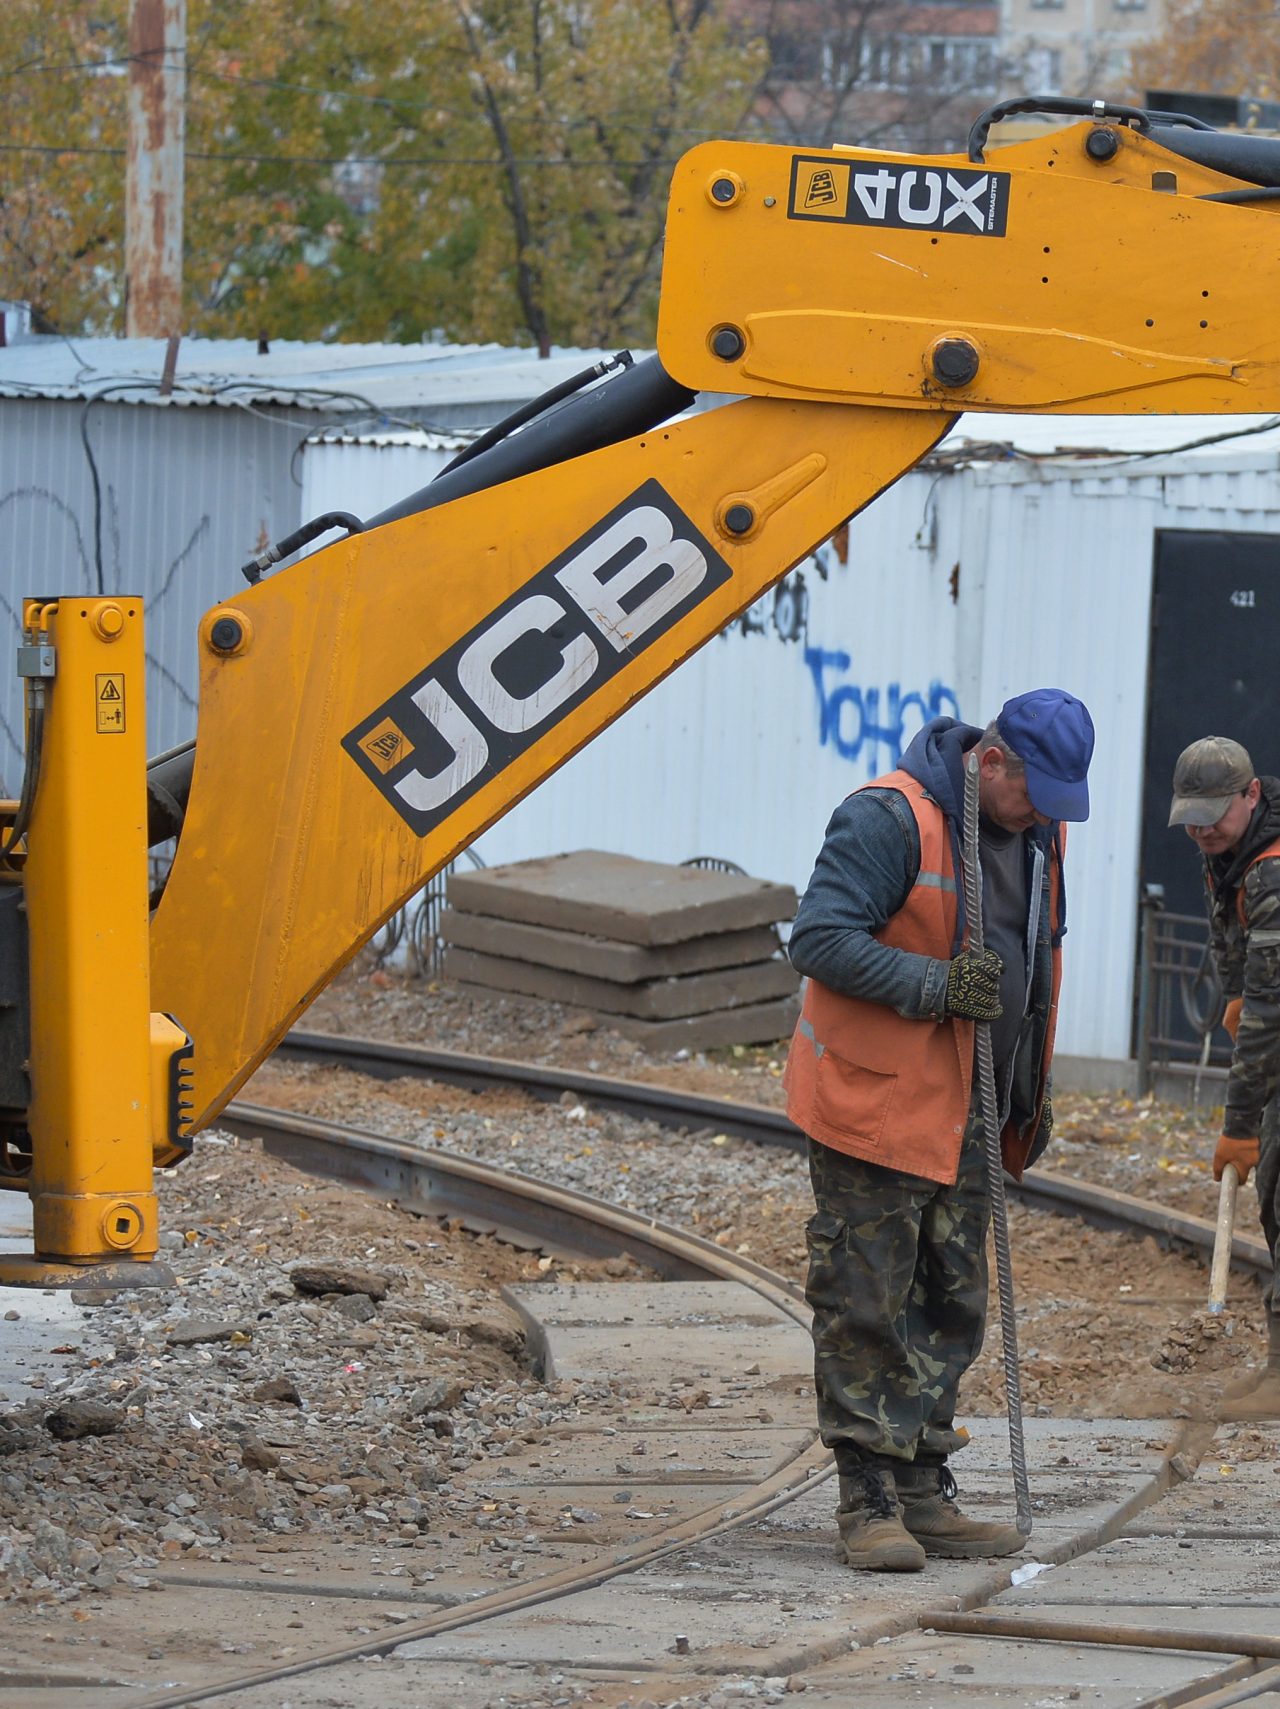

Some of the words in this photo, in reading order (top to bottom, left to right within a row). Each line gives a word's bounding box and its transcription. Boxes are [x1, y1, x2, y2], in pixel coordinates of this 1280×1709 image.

[808, 171, 835, 202] JCB
[854, 169, 988, 232] 4CX
[987, 177, 998, 231] SITEMASTER
[393, 505, 708, 811] JCB
[372, 732, 400, 758] JCB
